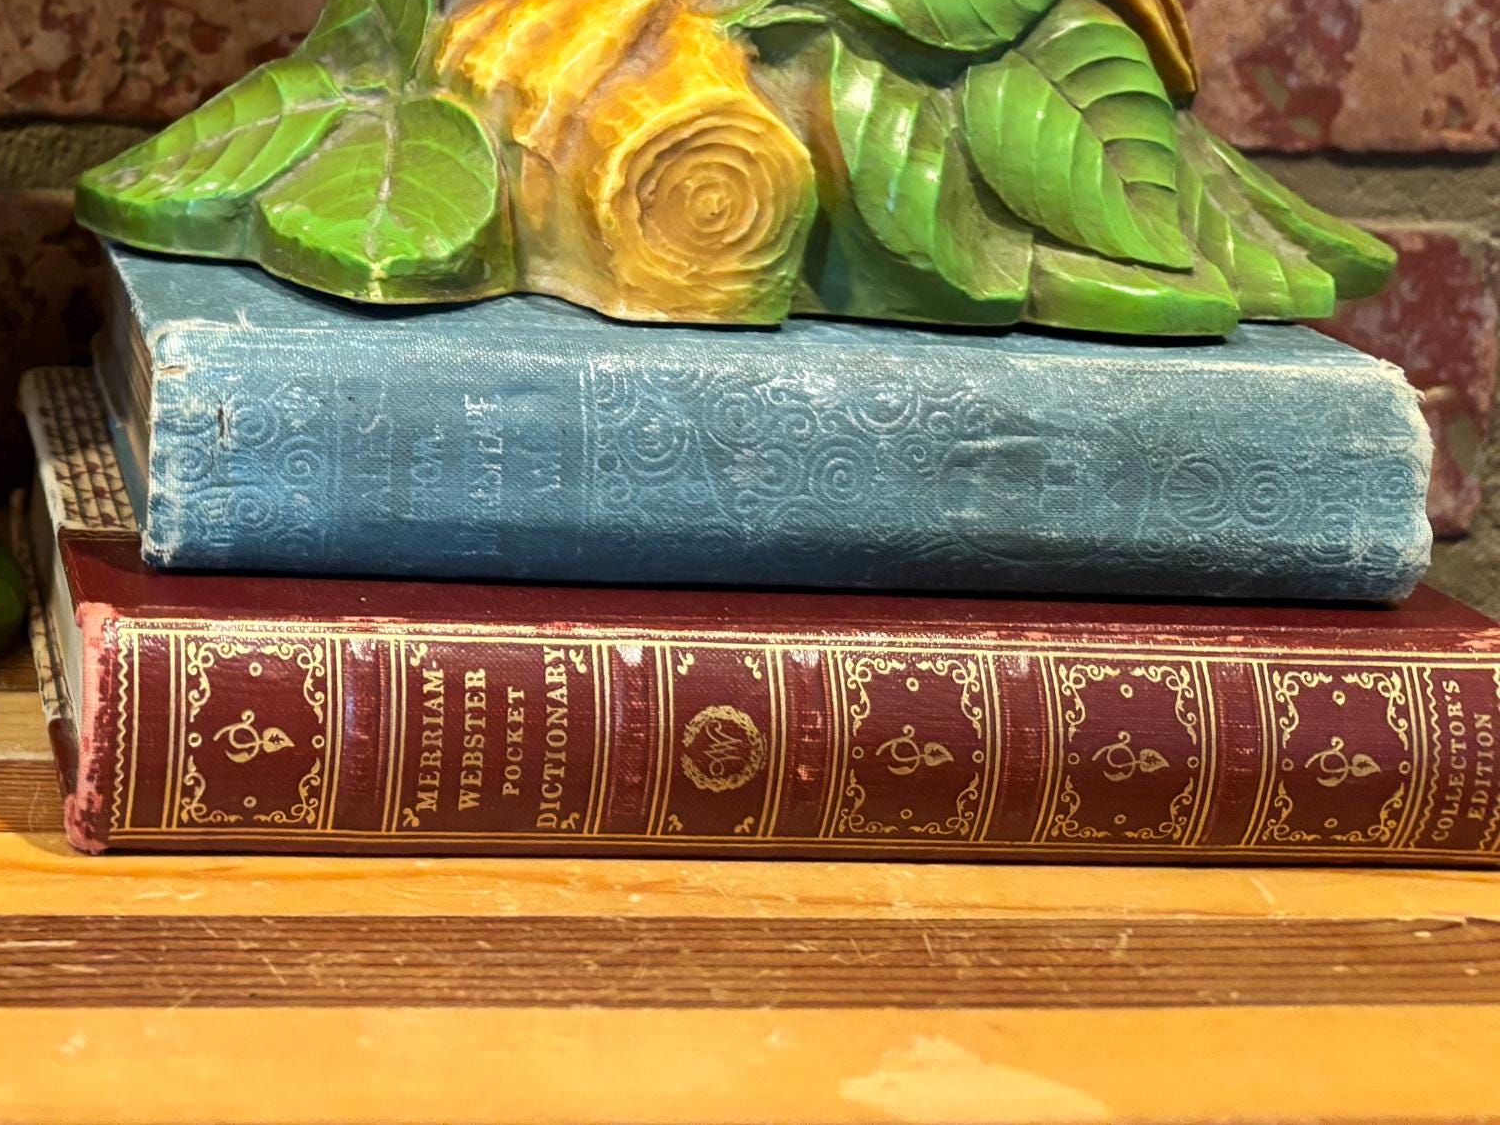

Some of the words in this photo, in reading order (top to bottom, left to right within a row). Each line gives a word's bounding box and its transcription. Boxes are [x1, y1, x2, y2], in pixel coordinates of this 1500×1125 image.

[415, 660, 444, 812] MERRIAM-
[458, 668, 486, 811] WEBSTER
[503, 686, 525, 797] POCKET
[536, 646, 568, 828] DICTIONARY
[1432, 680, 1467, 841] COLLECTOR'S
[1468, 713, 1495, 820] EDITION
